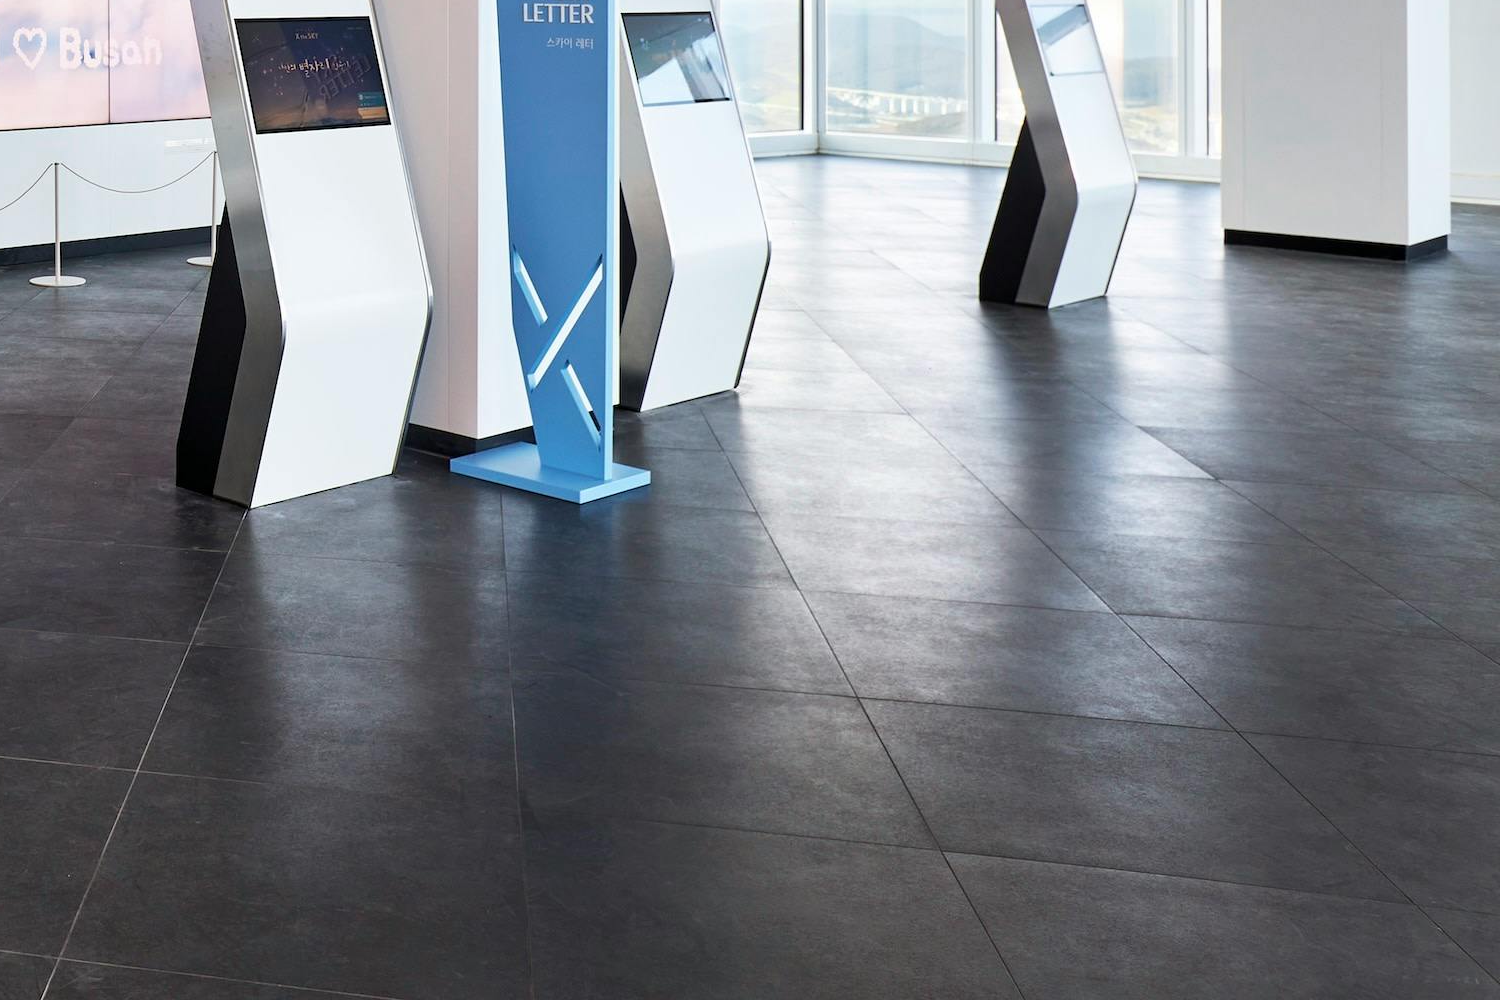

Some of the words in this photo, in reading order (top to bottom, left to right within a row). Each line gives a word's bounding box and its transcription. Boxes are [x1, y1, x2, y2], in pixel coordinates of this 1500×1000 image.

[523, 2, 594, 24] LETTER
[59, 26, 163, 70] Busan
[546, 37, 573, 49] 스카이
[575, 38, 594, 50] 레터
